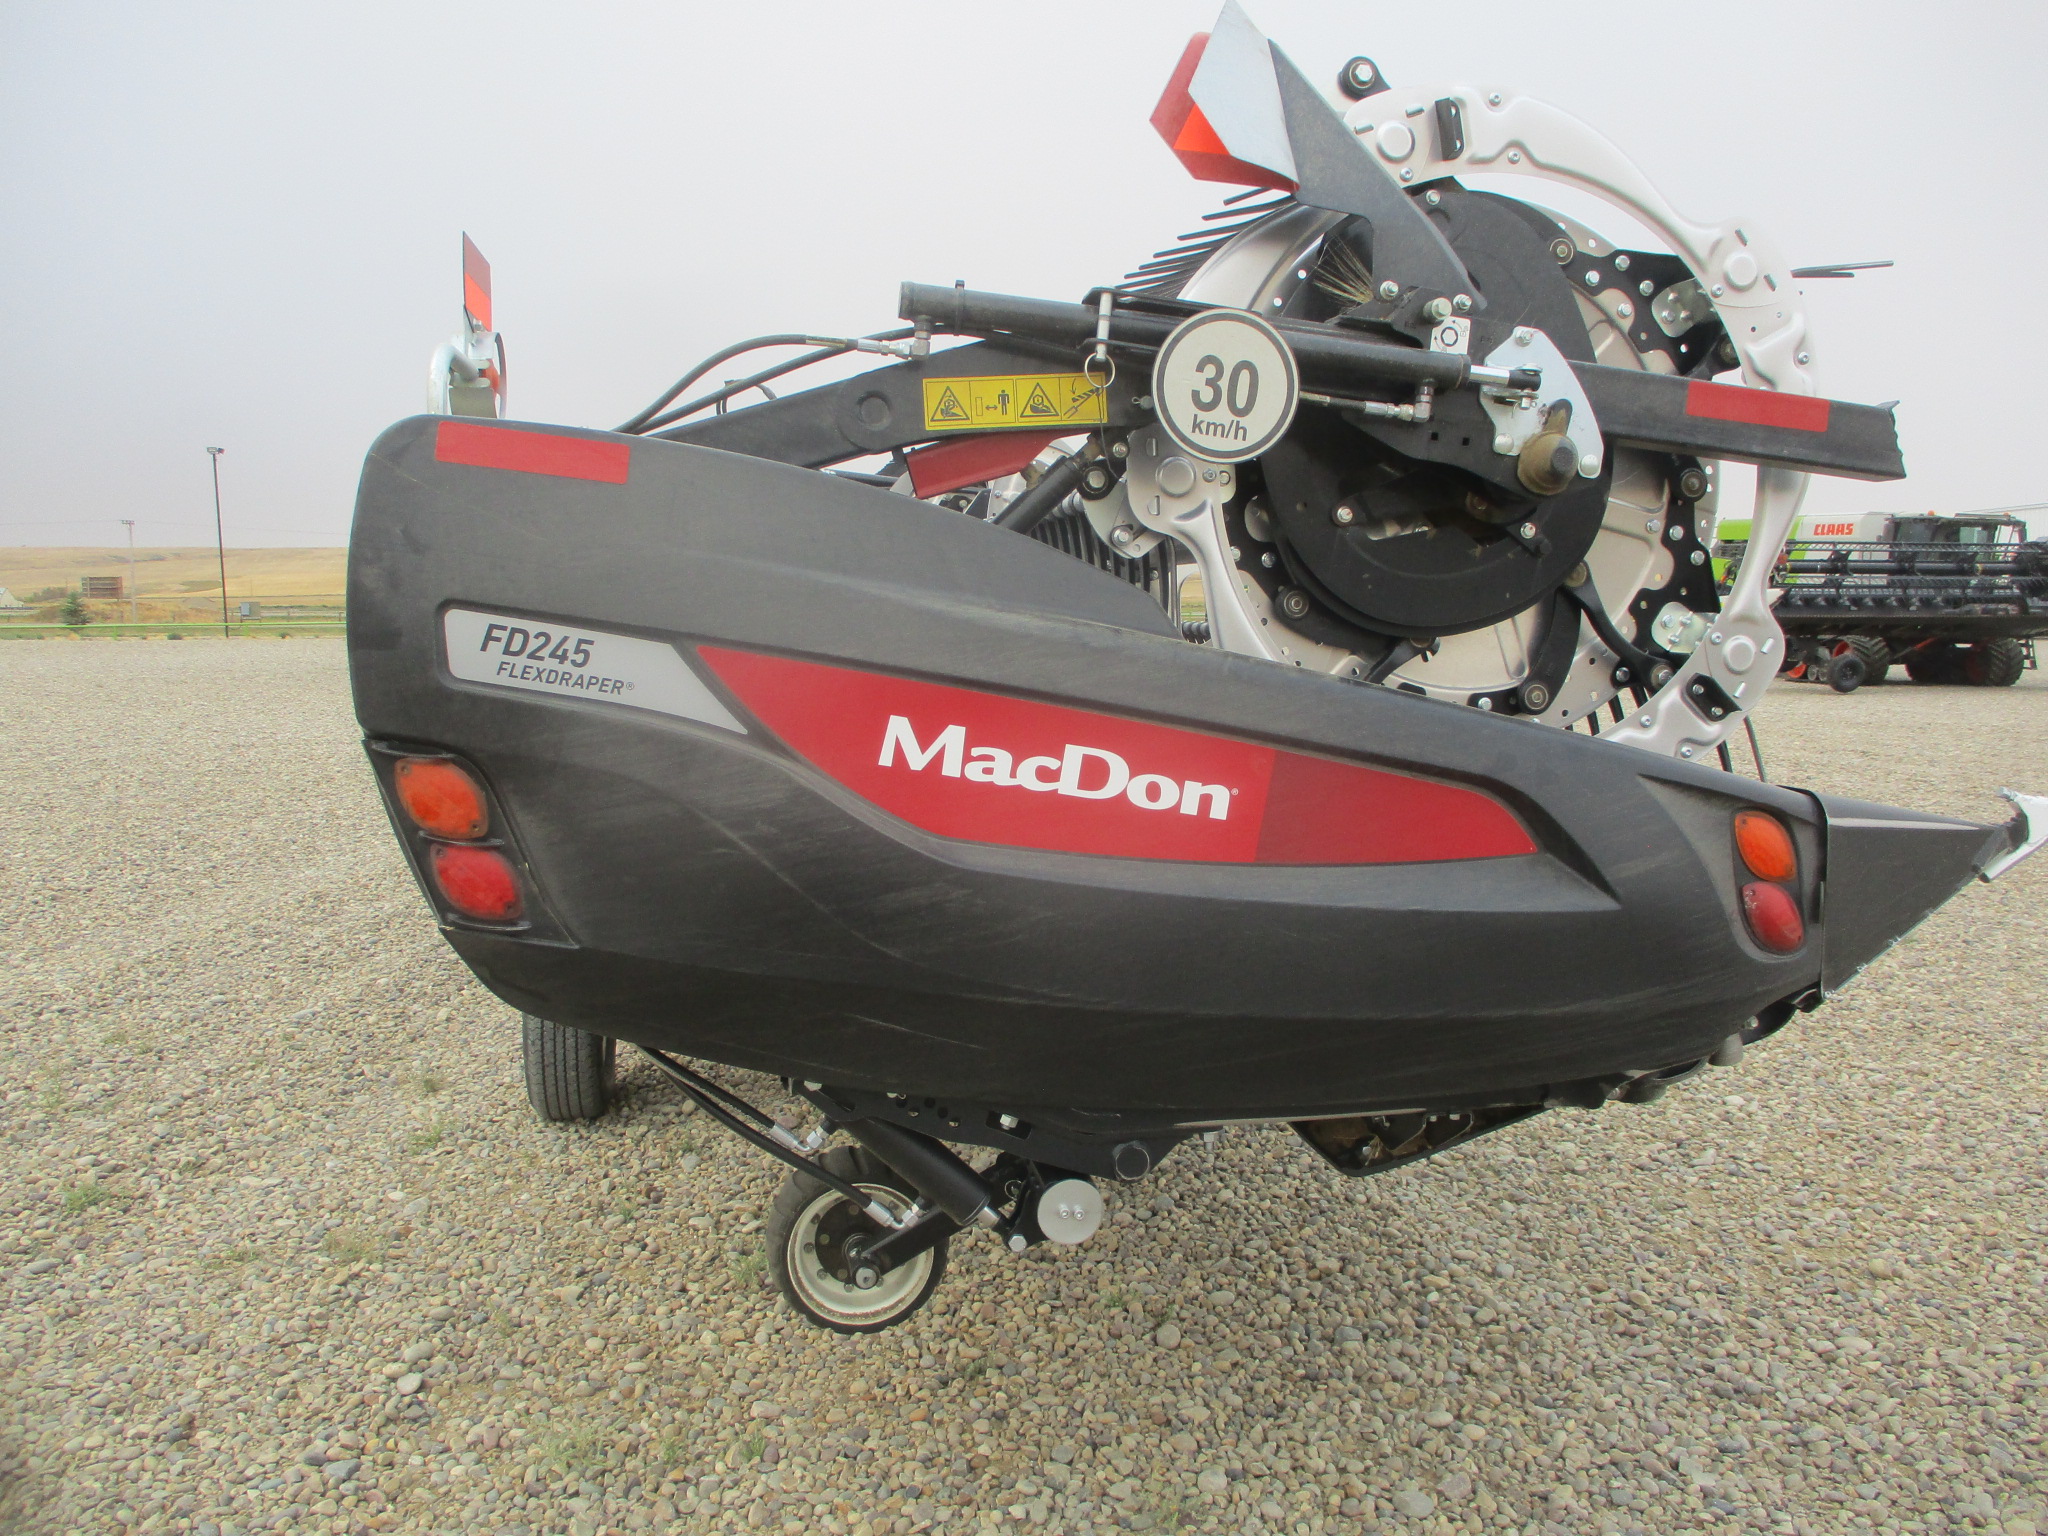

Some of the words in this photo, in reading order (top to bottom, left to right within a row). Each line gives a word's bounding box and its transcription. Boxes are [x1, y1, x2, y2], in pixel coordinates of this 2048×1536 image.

[1191, 354, 1260, 418] 30
[1190, 413, 1248, 442] km/h
[1813, 523, 1854, 536] CLAAS
[480, 623, 595, 668] FD245
